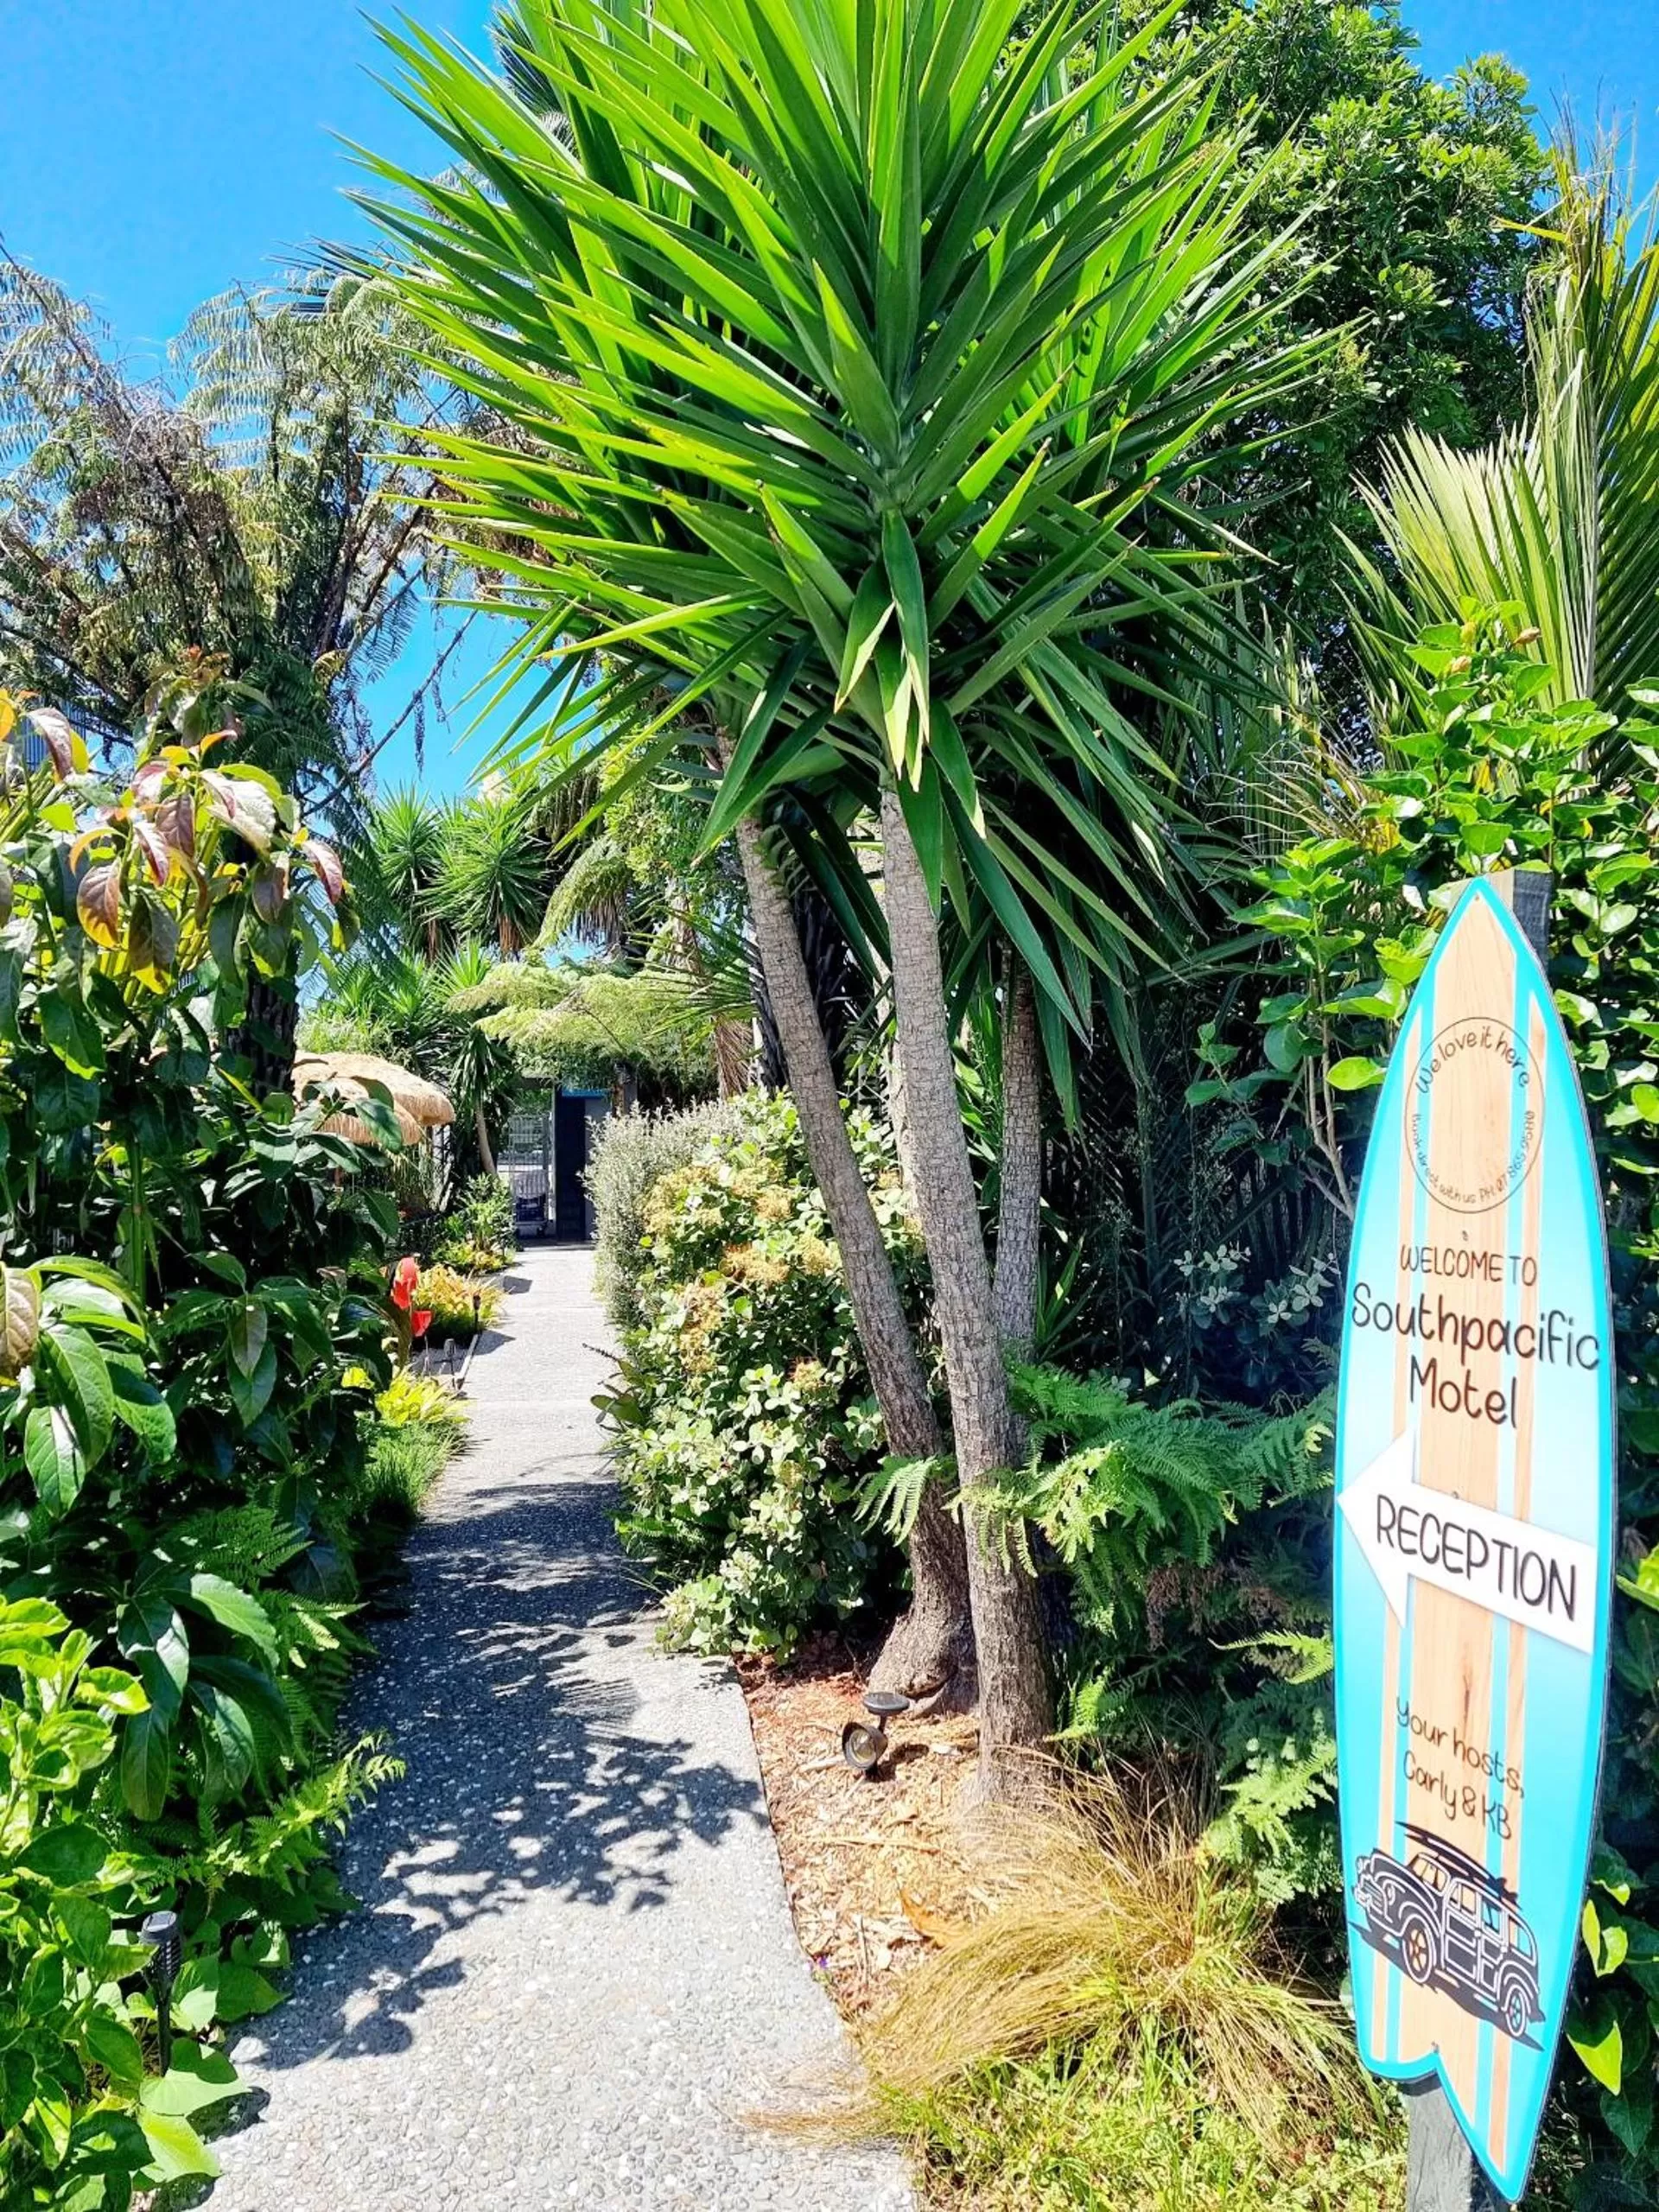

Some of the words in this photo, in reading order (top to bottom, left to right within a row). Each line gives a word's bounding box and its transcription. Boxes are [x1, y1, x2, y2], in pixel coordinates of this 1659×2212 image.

[1415, 1058, 1441, 1093] We
[1438, 1032, 1478, 1061] love
[1480, 1026, 1493, 1049] it
[1495, 1030, 1529, 1088] here
[1440, 1184, 1461, 1203] with
[1462, 1194, 1476, 1204] us
[1400, 1244, 1503, 1282] WELCOME
[1509, 1255, 1537, 1287] TO
[1351, 1282, 1600, 1370] Southpacific
[1410, 1354, 1516, 1429] Motel
[1376, 1494, 1576, 1622] RECEPTION
[1396, 1695, 1448, 1747] your
[1403, 1750, 1457, 1821] Carly
[1482, 1793, 1512, 1840] KB
